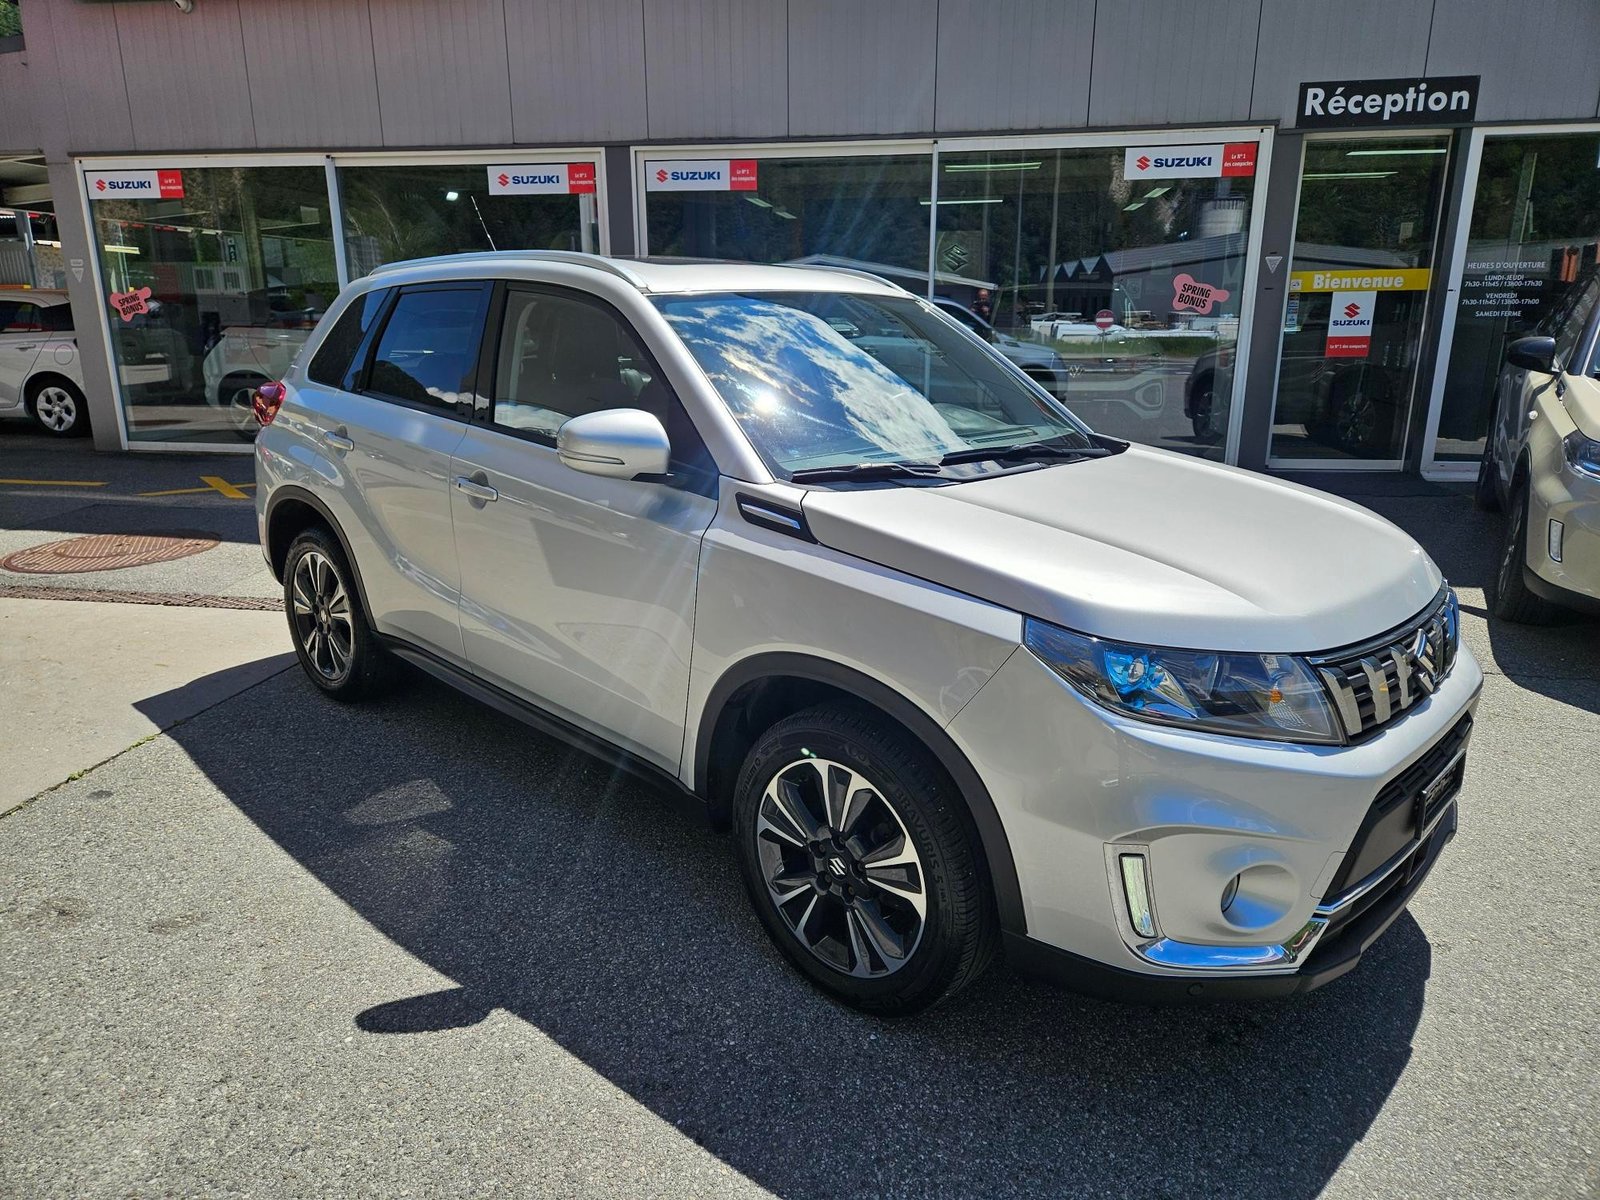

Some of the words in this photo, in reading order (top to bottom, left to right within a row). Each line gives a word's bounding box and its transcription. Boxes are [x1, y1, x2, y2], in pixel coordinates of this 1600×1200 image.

[1304, 82, 1470, 121] Réception
[1153, 156, 1212, 168] SUZUKI
[511, 175, 560, 184] SUZUKI
[671, 171, 721, 181] SUZUKI
[108, 180, 152, 190] SUZUKI
[1495, 261, 1546, 269] D'OUVERTURE
[1313, 273, 1404, 289] Bienvenue
[1181, 283, 1211, 298] SPRING
[118, 293, 140, 307] SPRING
[1177, 293, 1207, 308] BONUS
[121, 302, 143, 316] BONUS
[1332, 319, 1370, 327] SUZUKI
